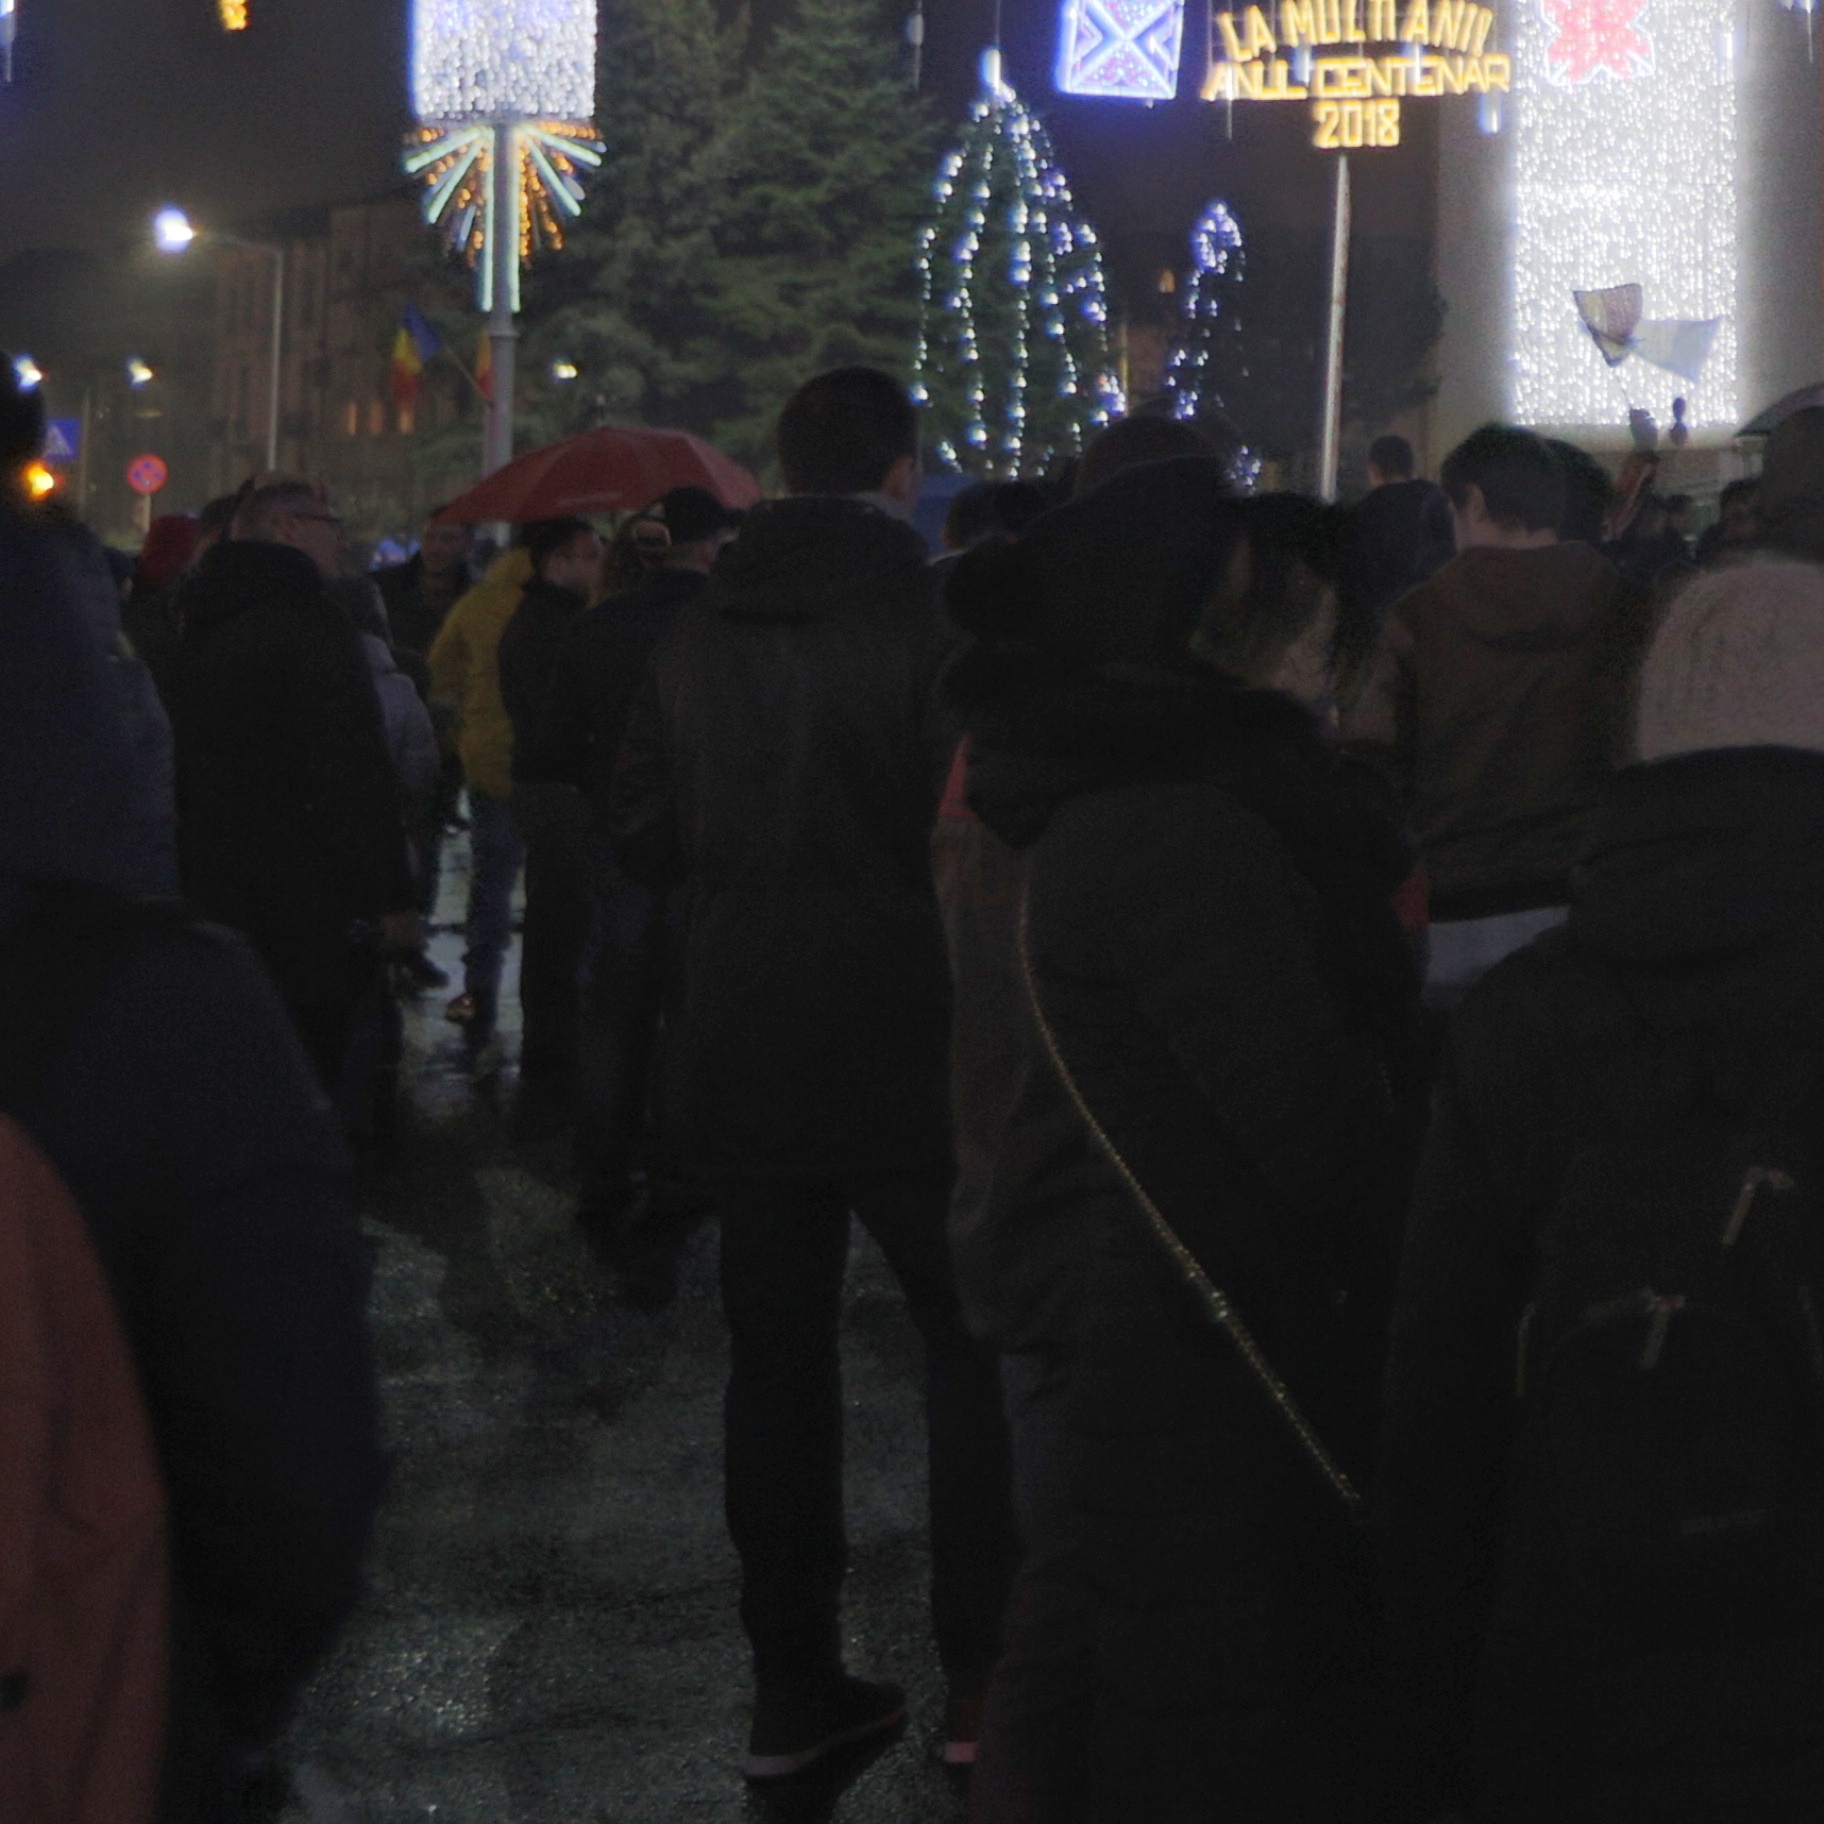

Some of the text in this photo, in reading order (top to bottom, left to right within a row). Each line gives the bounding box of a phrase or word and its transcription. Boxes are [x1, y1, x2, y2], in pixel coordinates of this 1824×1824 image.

[1217, 4, 1278, 62] LA
[1200, 52, 1512, 102] ANUL CENTENAR
[1312, 97, 1401, 150] 2018
